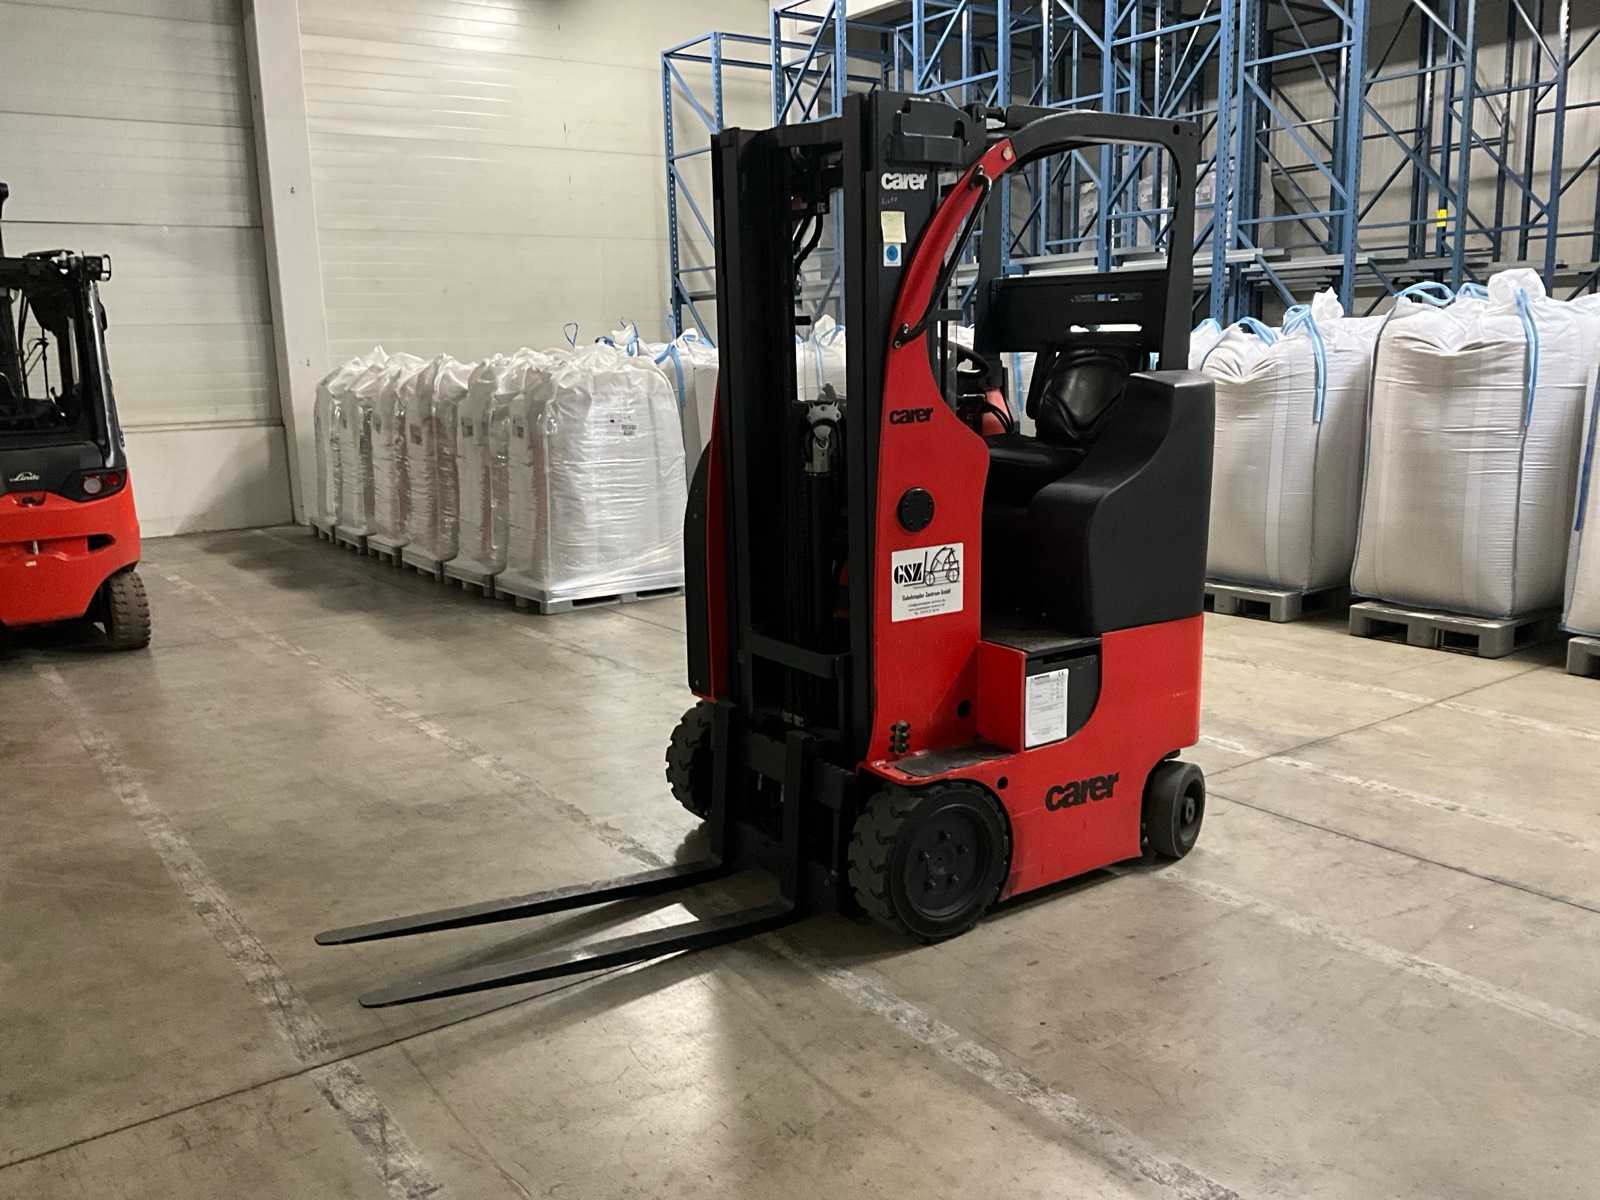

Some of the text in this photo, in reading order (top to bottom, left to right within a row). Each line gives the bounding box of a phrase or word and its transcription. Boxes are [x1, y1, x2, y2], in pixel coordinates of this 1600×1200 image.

[881, 172, 928, 190] carer
[889, 407, 934, 425] carer
[894, 562, 922, 584] GSZ
[1045, 771, 1120, 812] carer
